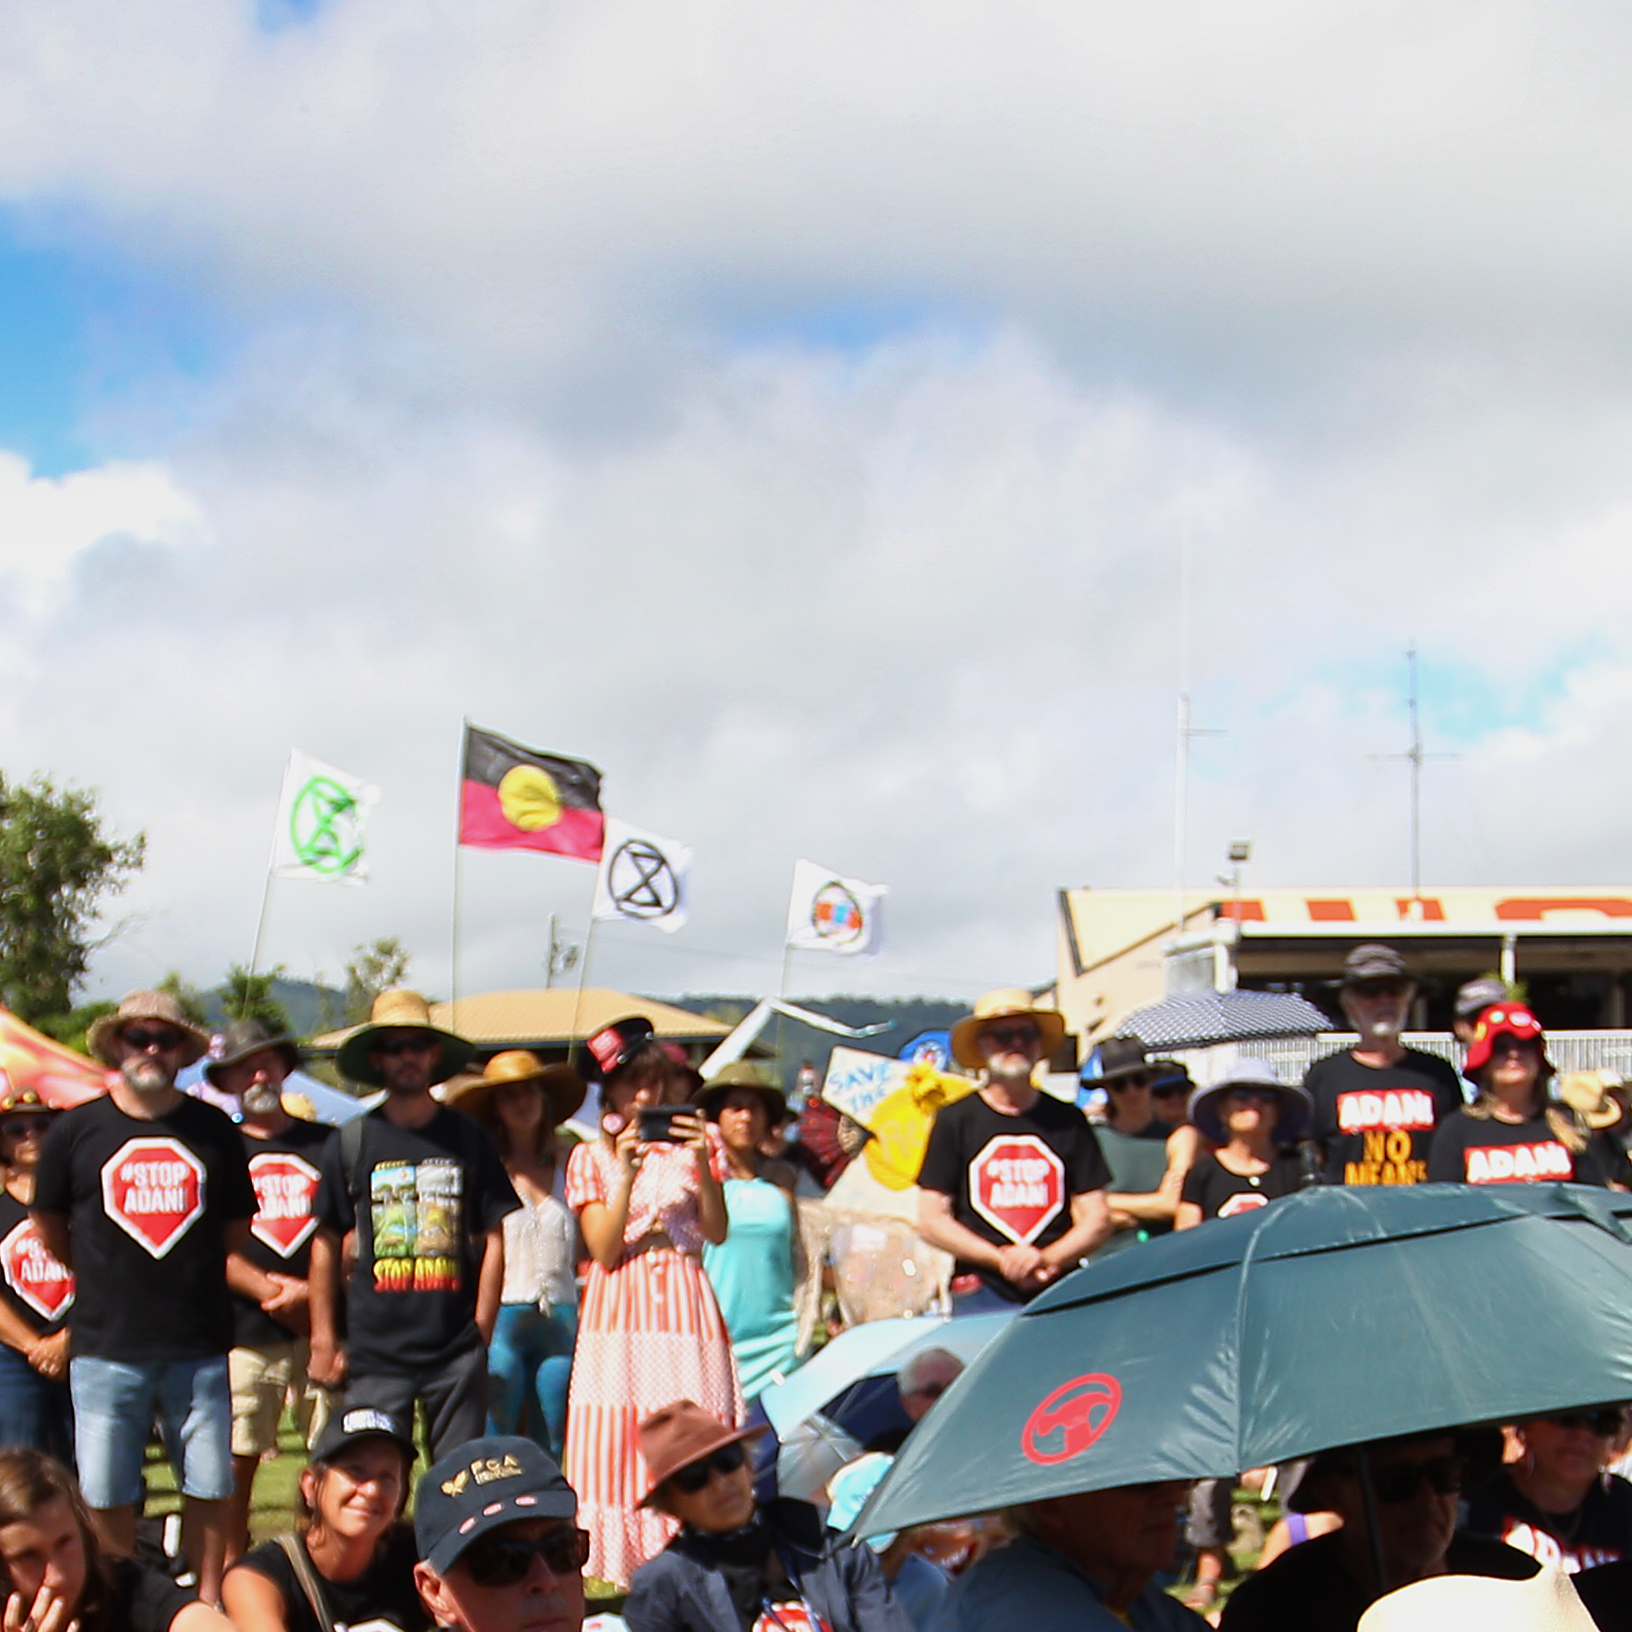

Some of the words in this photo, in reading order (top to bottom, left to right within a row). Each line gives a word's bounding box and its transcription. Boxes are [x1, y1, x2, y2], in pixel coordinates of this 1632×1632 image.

[828, 1061, 891, 1092] SAVE
[1339, 1090, 1434, 1129] ADANI
[1364, 1131, 1413, 1163] NO
[1466, 1142, 1573, 1182] ADANI
[120, 1161, 191, 1187] #STOP
[124, 1186, 188, 1214] ADANI
